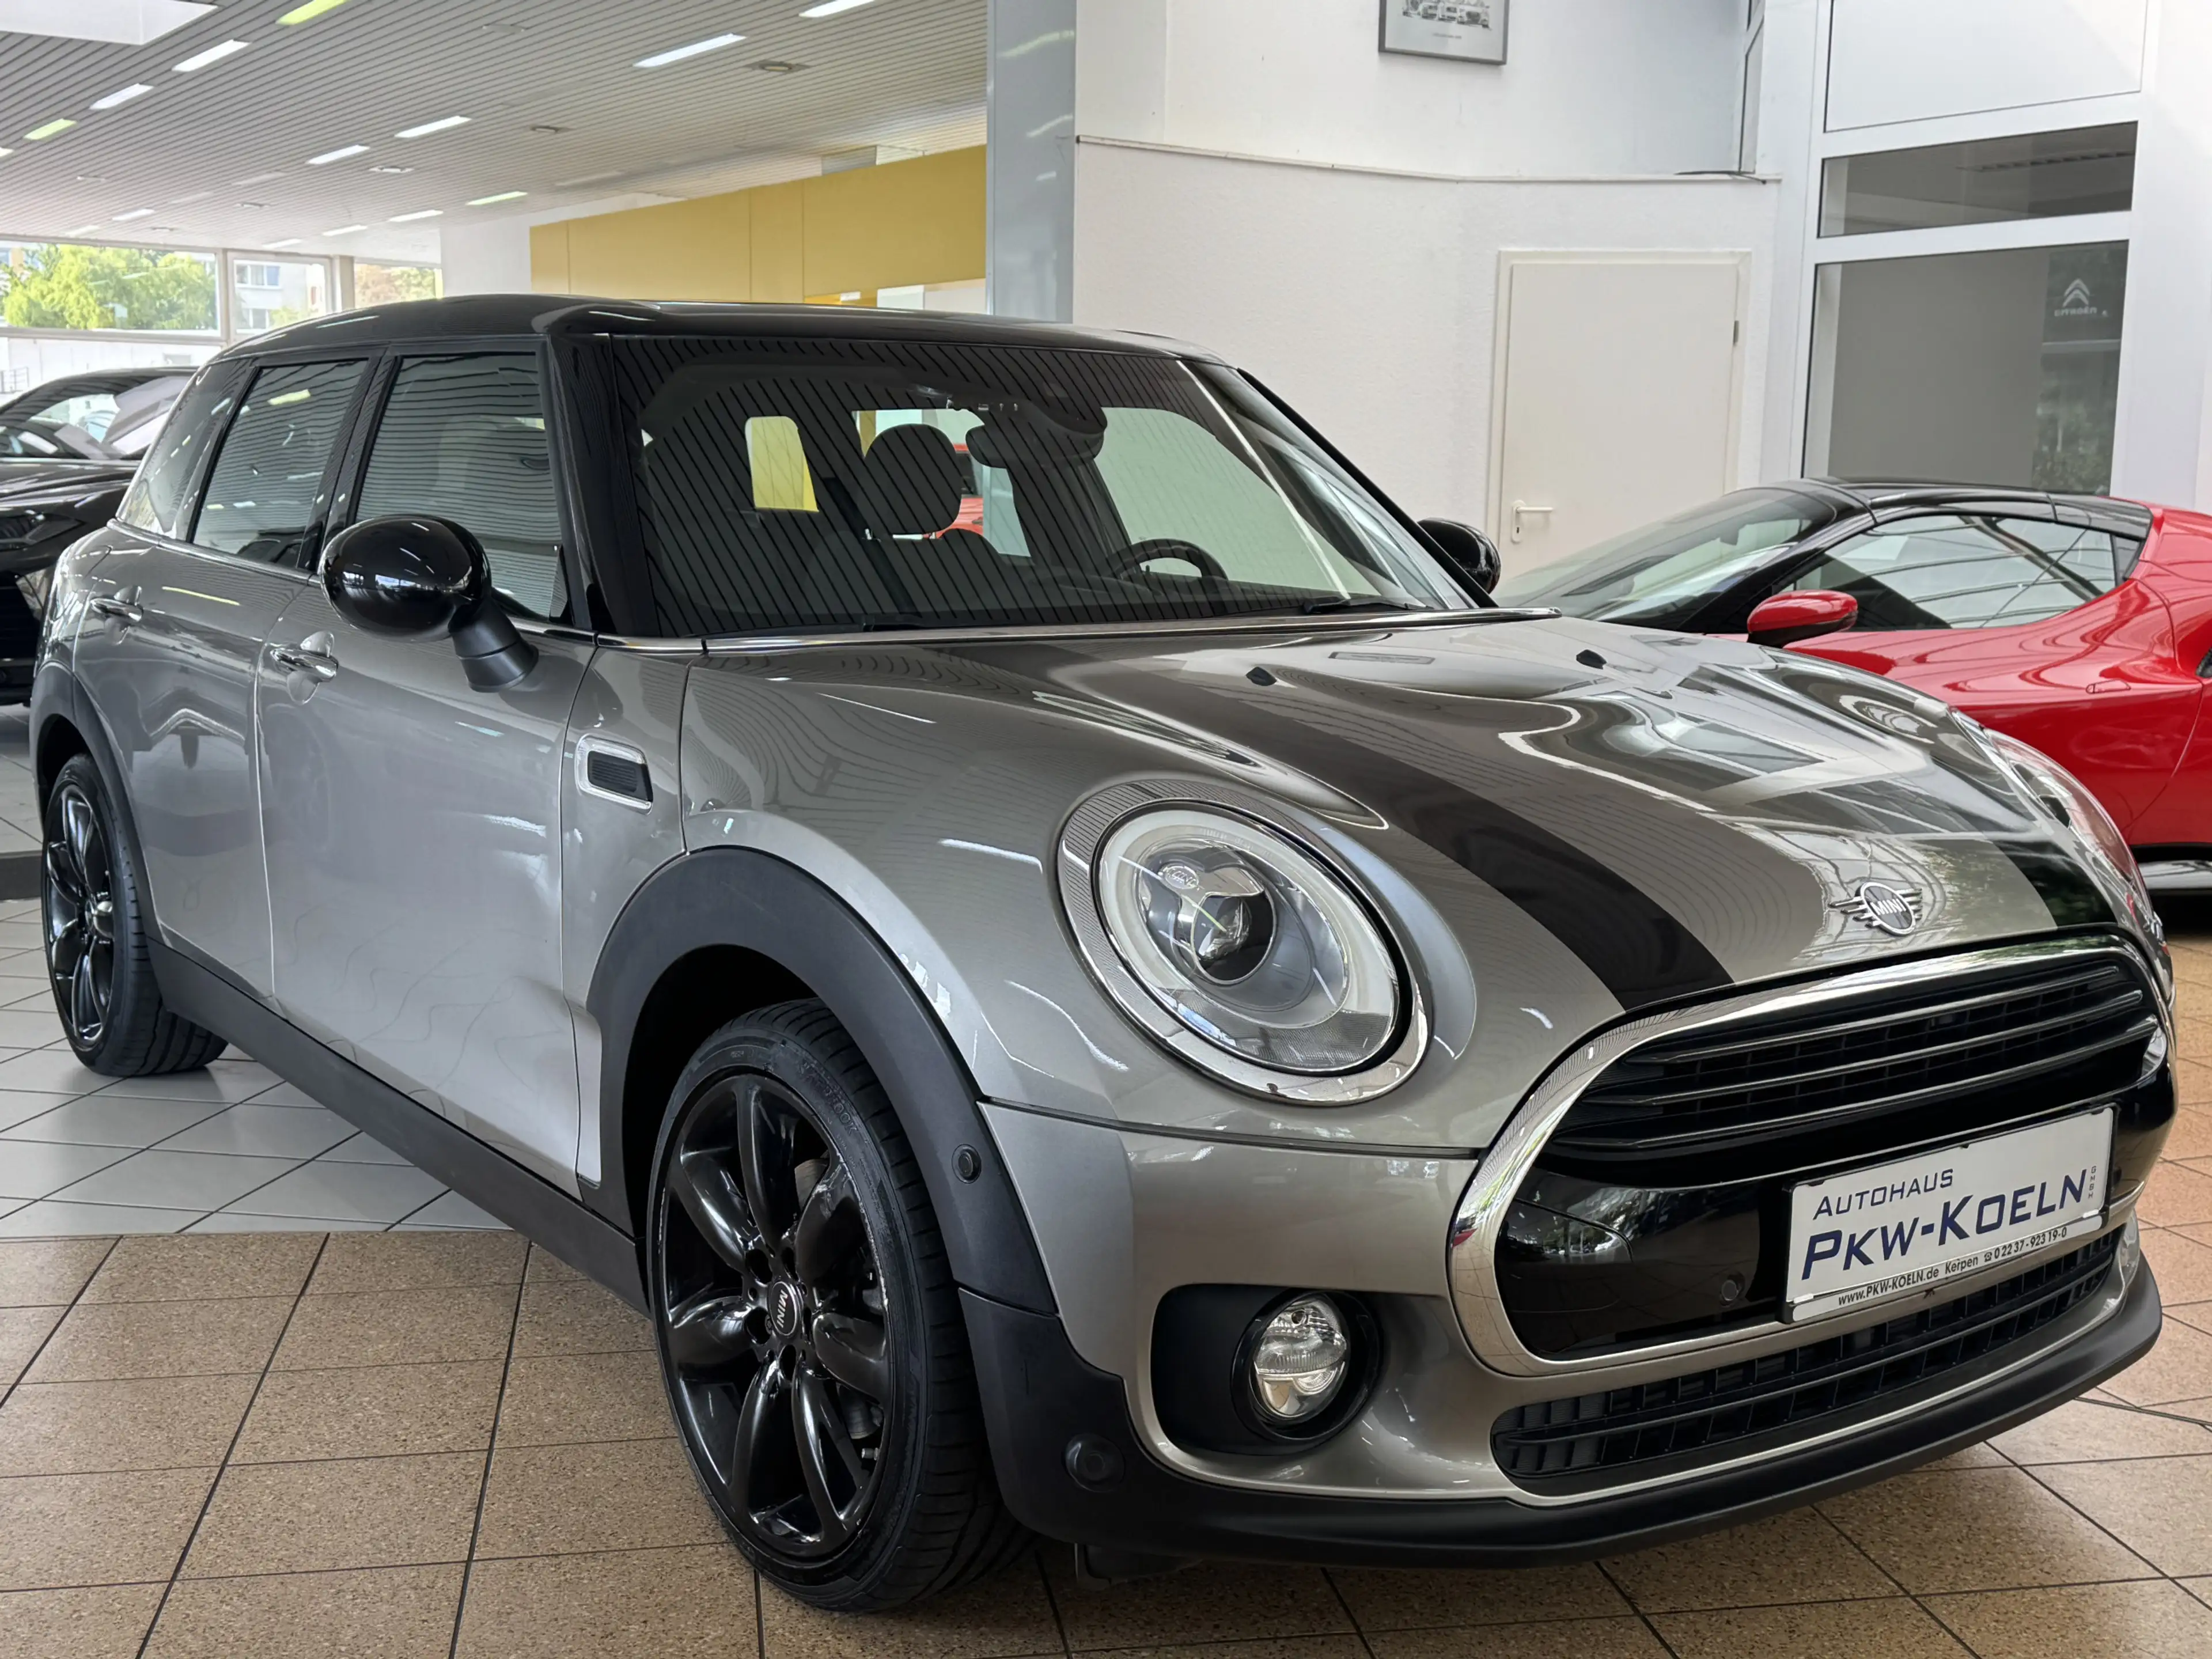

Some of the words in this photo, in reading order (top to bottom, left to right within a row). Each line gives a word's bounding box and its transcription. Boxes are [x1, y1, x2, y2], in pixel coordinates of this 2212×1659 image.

[1870, 898, 1907, 915] MINI
[1812, 1168, 1953, 1220] AUTOHAUS
[1801, 1169, 2087, 1281] PKW-KOELN
[1838, 1267, 1939, 1306] www.PKW-KOELN.de
[1945, 1256, 1978, 1275] Kerpen
[777, 1289, 788, 1328] MINI
